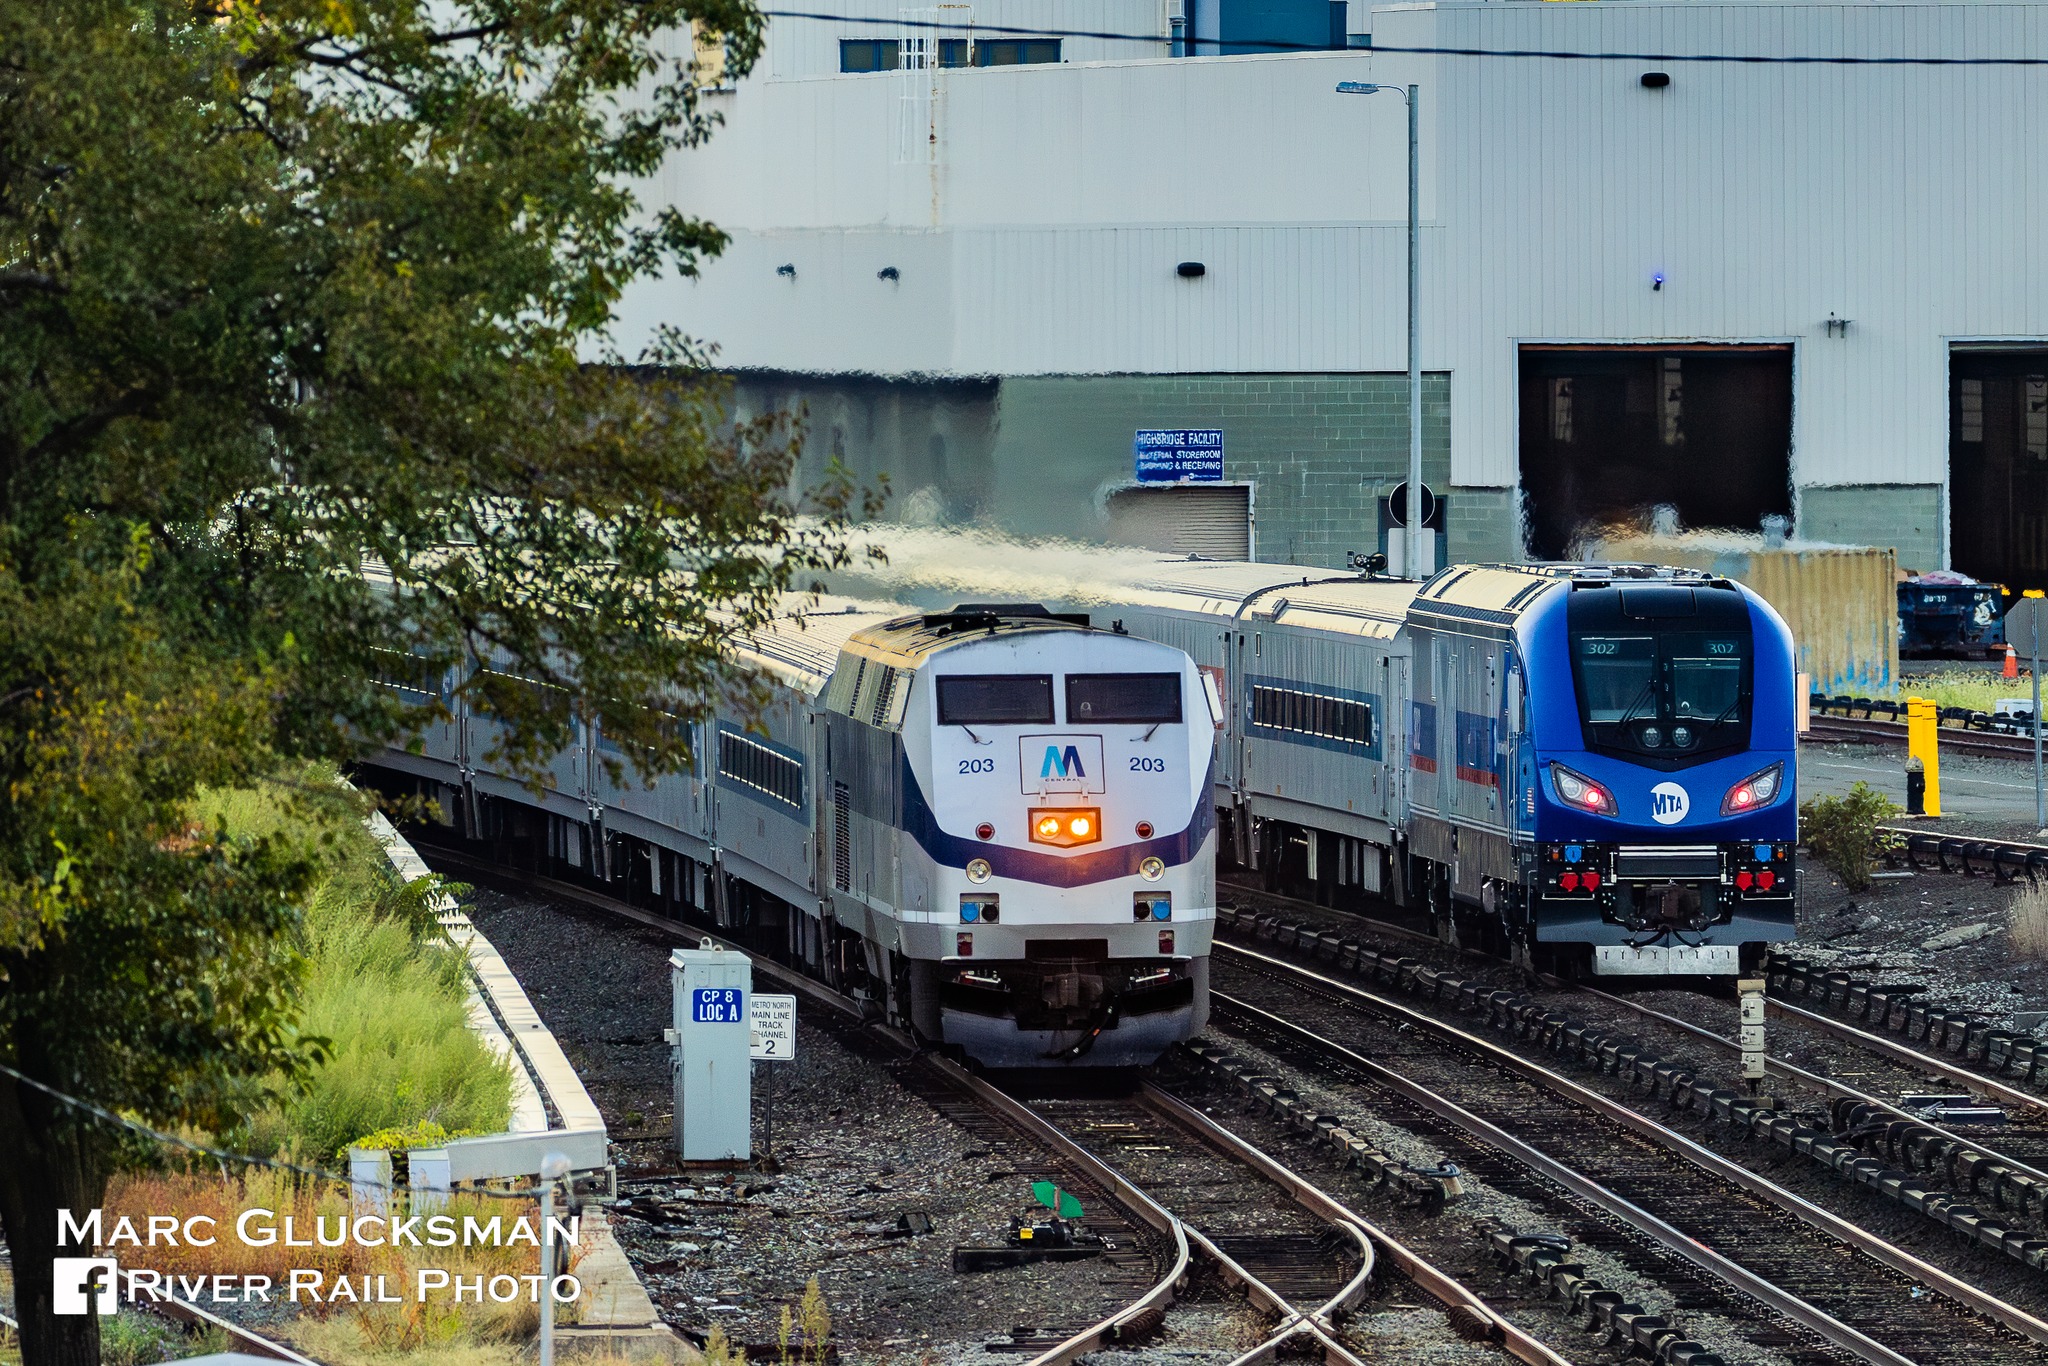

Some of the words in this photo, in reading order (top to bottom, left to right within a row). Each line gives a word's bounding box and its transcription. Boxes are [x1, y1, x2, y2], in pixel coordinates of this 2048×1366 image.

[1138, 432, 1185, 445] HIGHBRIDGE
[1188, 432, 1221, 445] FACILITY
[1176, 450, 1221, 459] STOREROOM
[1175, 461, 1181, 470] &
[1182, 461, 1221, 470] RECEIVING
[1587, 643, 1616, 654] 302
[958, 758, 994, 774] 203
[1129, 757, 1165, 772] 203
[1651, 792, 1683, 816] MTA
[702, 990, 720, 1003] CP
[725, 990, 734, 1003] 8
[699, 1003, 724, 1021] LOC
[729, 1003, 738, 1021] A
[751, 1011, 771, 1019] MAIN
[773, 1012, 790, 1020] LINE
[758, 1021, 783, 1029] TRACK
[752, 1030, 788, 1039] HANNEL
[765, 1040, 776, 1055] 2
